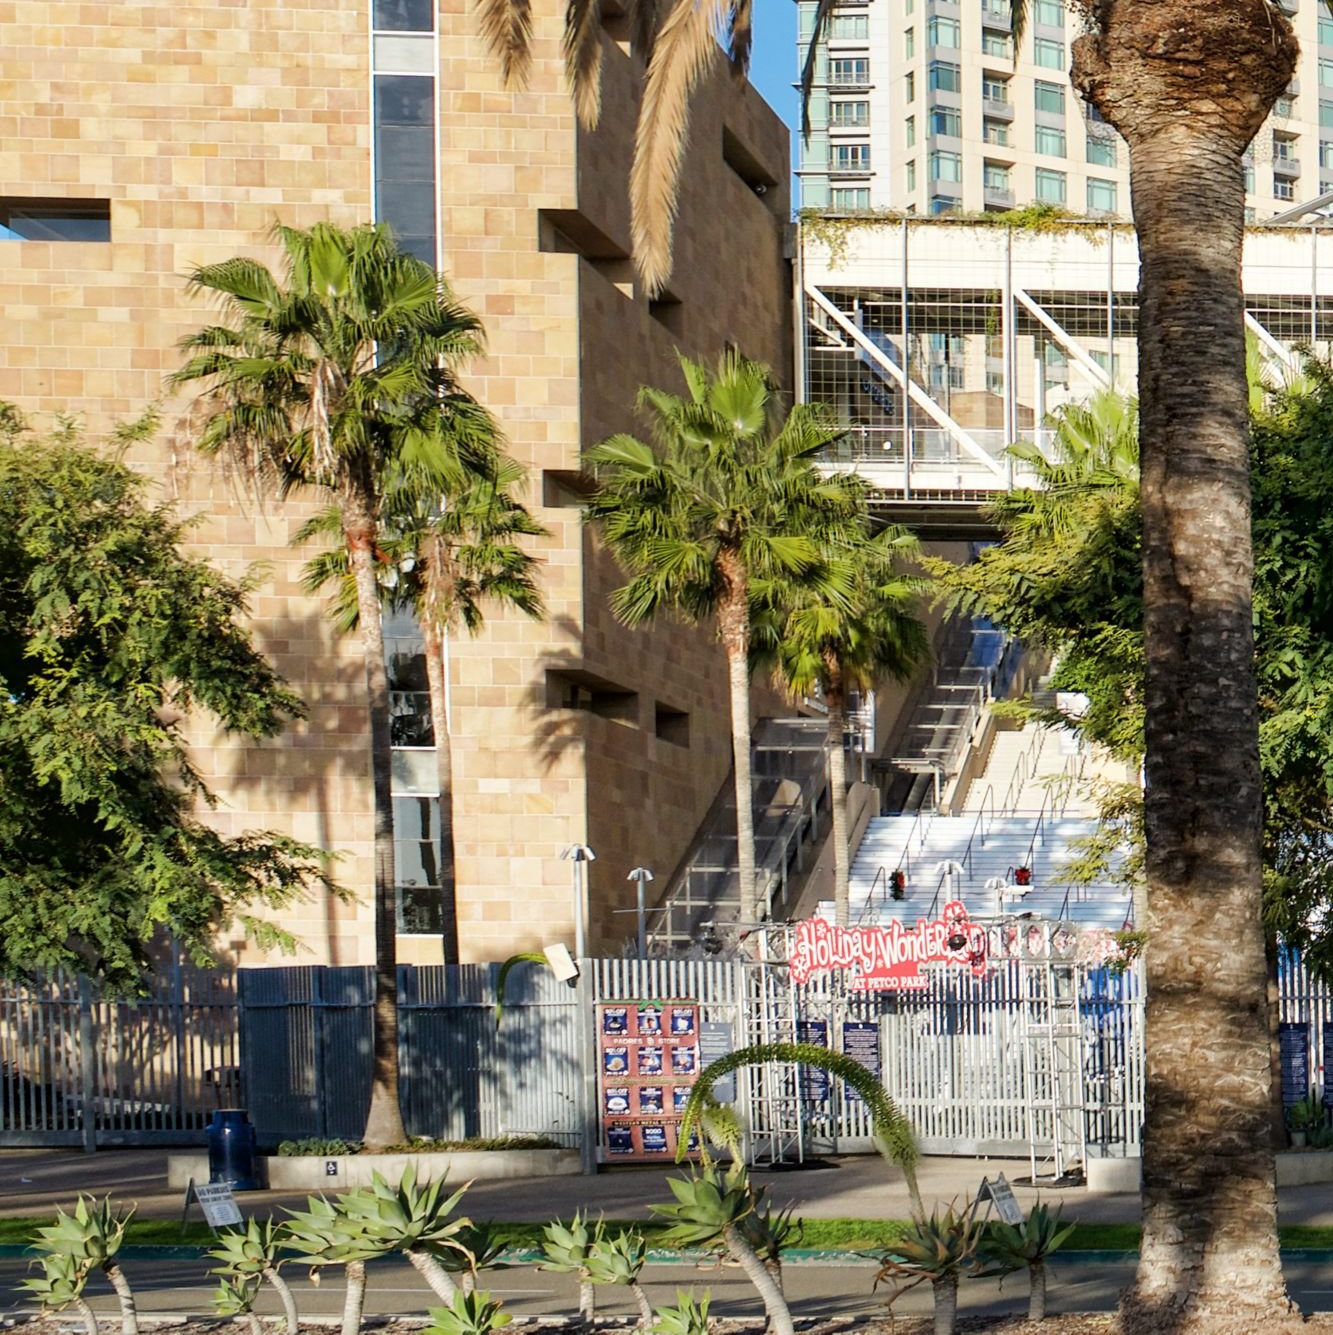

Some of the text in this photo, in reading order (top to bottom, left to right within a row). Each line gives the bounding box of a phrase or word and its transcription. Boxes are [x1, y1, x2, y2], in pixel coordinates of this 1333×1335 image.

[854, 976, 927, 989] AT PETCO PARK
